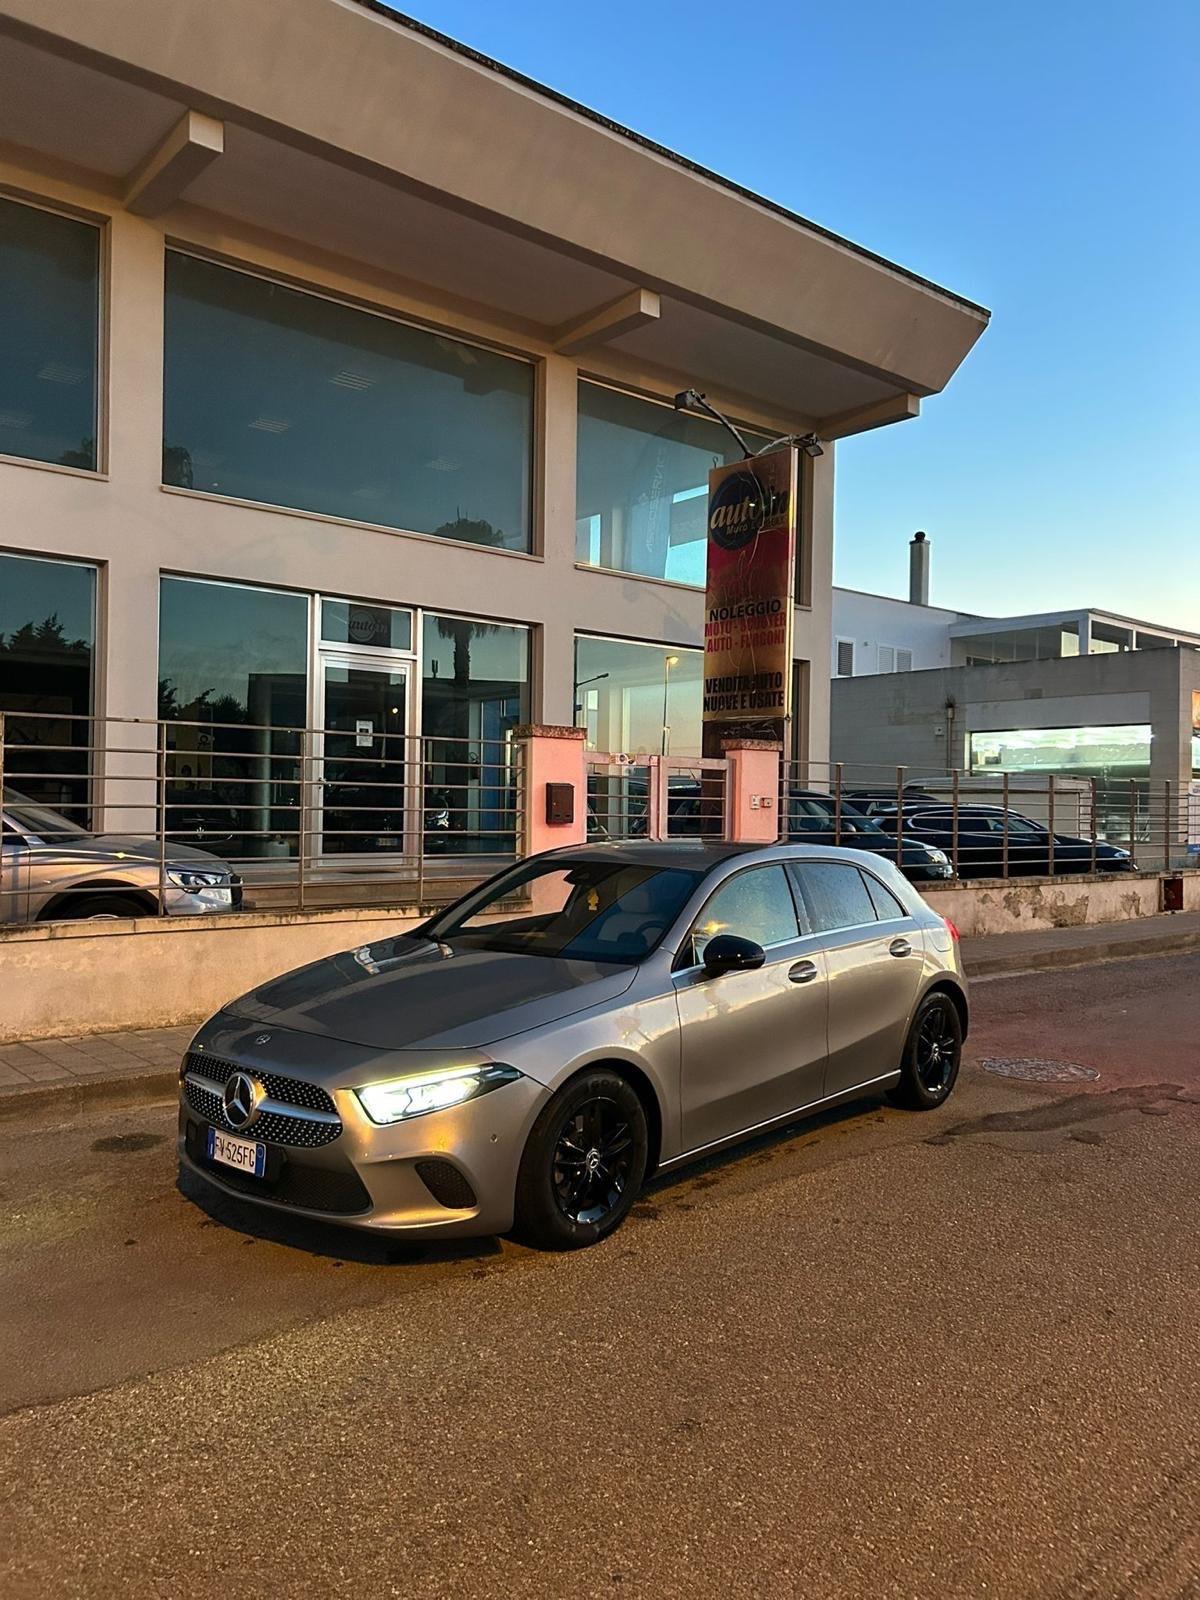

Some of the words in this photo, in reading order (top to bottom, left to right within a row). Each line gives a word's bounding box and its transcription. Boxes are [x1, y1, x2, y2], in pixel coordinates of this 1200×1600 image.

[709, 600, 781, 621] NOLEGGIO
[705, 620, 732, 637] MOTO
[707, 637, 732, 652] AUTO
[705, 676, 750, 693] VENDITA
[752, 671, 783, 690] AUTO
[704, 695, 738, 711] NUOVE
[740, 693, 747, 709] E
[749, 691, 785, 708] USATE
